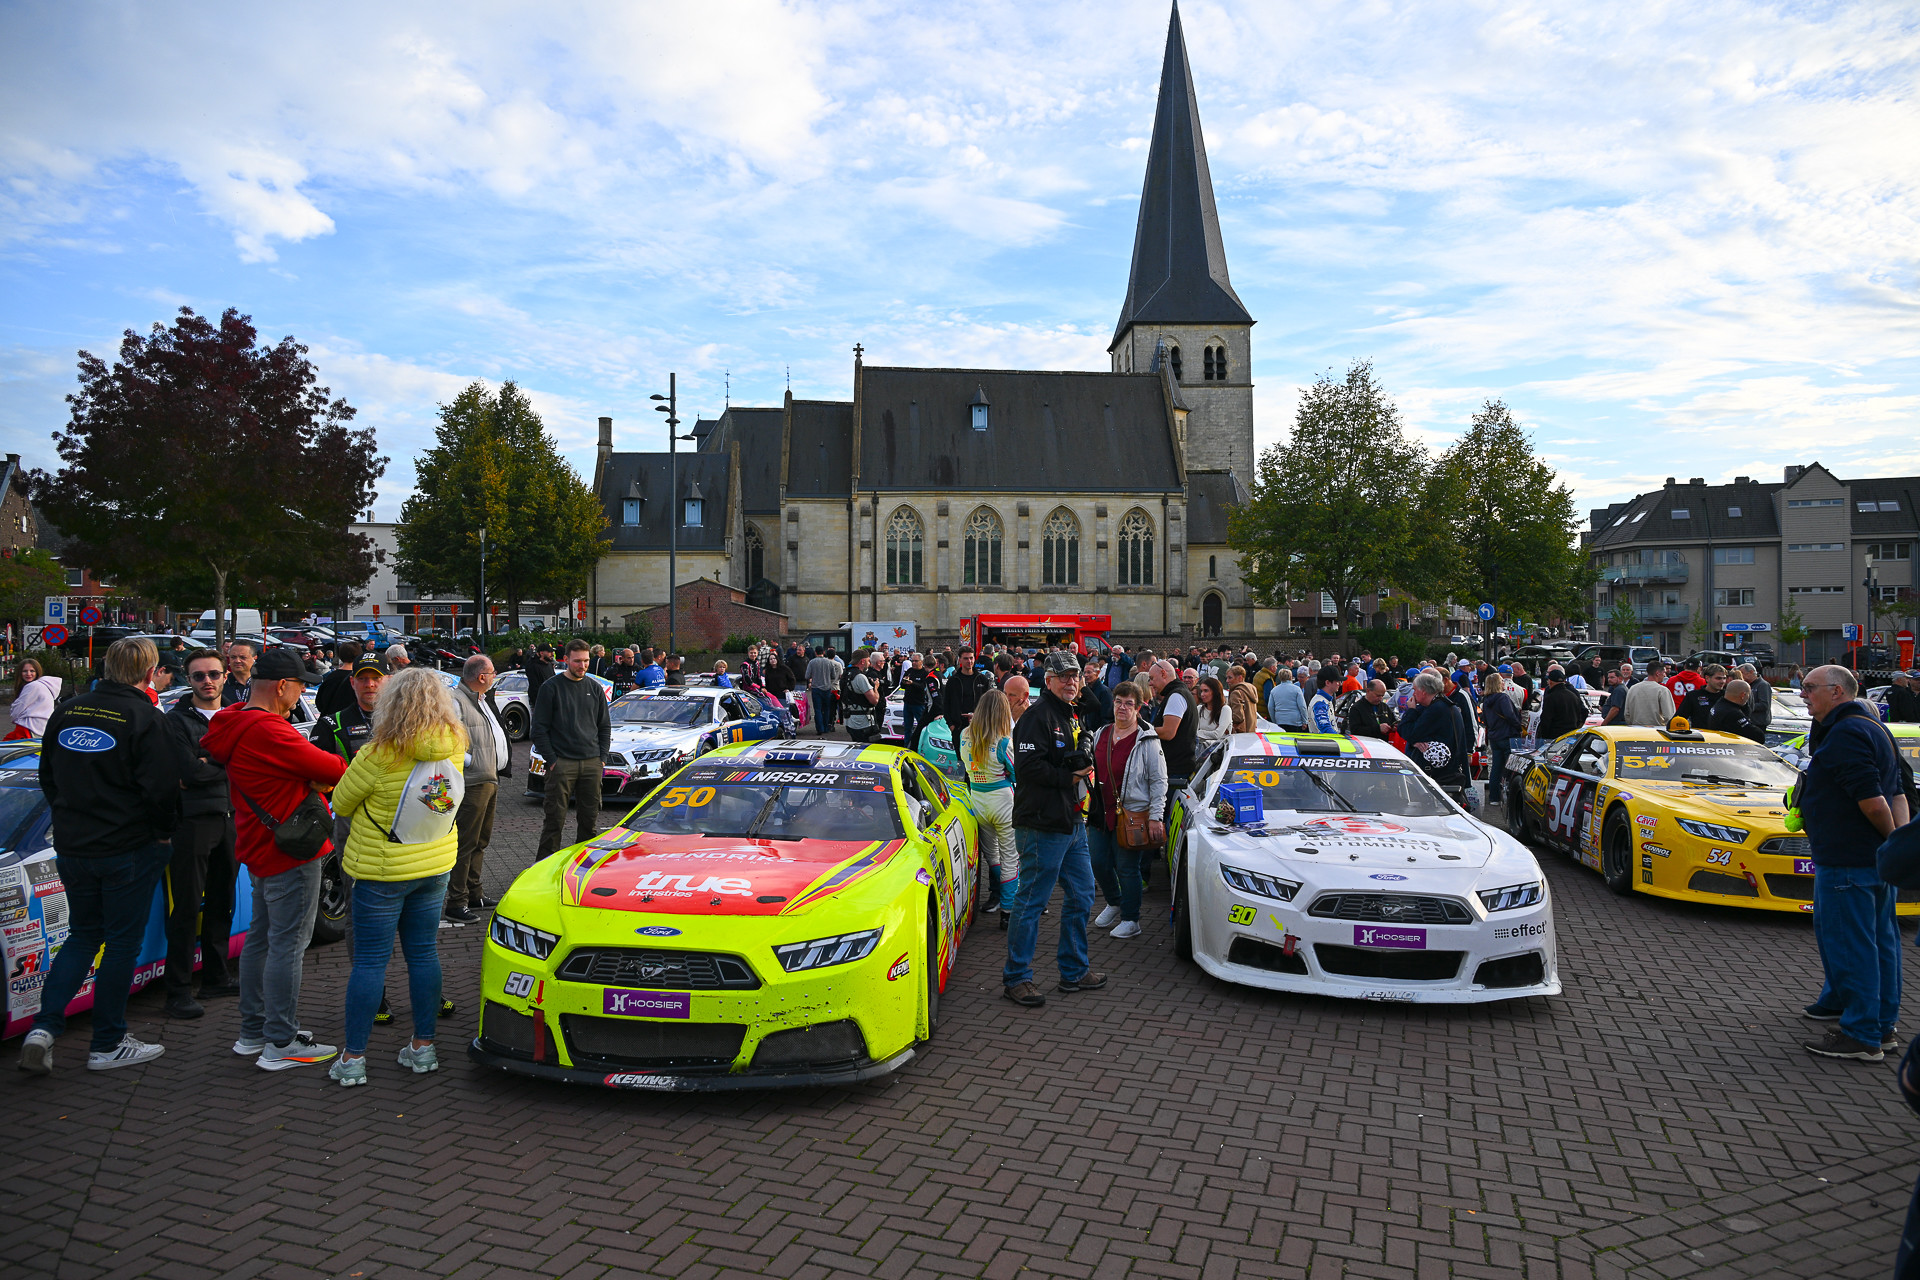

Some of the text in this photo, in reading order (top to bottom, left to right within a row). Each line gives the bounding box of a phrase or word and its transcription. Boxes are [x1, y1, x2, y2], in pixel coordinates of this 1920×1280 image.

[51, 604, 61, 615] P
[67, 729, 102, 748] Ford
[1676, 746, 1736, 756] NASCAR
[935, 753, 948, 764] 73
[1298, 757, 1371, 769] NASCAR
[1623, 755, 1671, 769] 54
[750, 771, 840, 785] NASCAR
[1235, 769, 1280, 787] 30
[660, 786, 717, 808] 50
[1548, 777, 1583, 839] 54
[1636, 815, 1658, 827] Caval
[1304, 841, 1445, 852] AUTOMOTIVE
[1643, 843, 1671, 856] KENNOL
[645, 852, 796, 863] HENDRIKS
[1706, 848, 1732, 866] 54
[1376, 873, 1401, 881] Ford
[627, 889, 694, 898] industries
[1228, 904, 1257, 926] 30
[3, 920, 40, 936] WHELEN
[643, 926, 673, 936] Ford
[1376, 933, 1421, 942] HOOSIER
[505, 971, 535, 998] 50
[628, 999, 683, 1009] HOOSIER
[609, 1073, 677, 1085] KENNO
